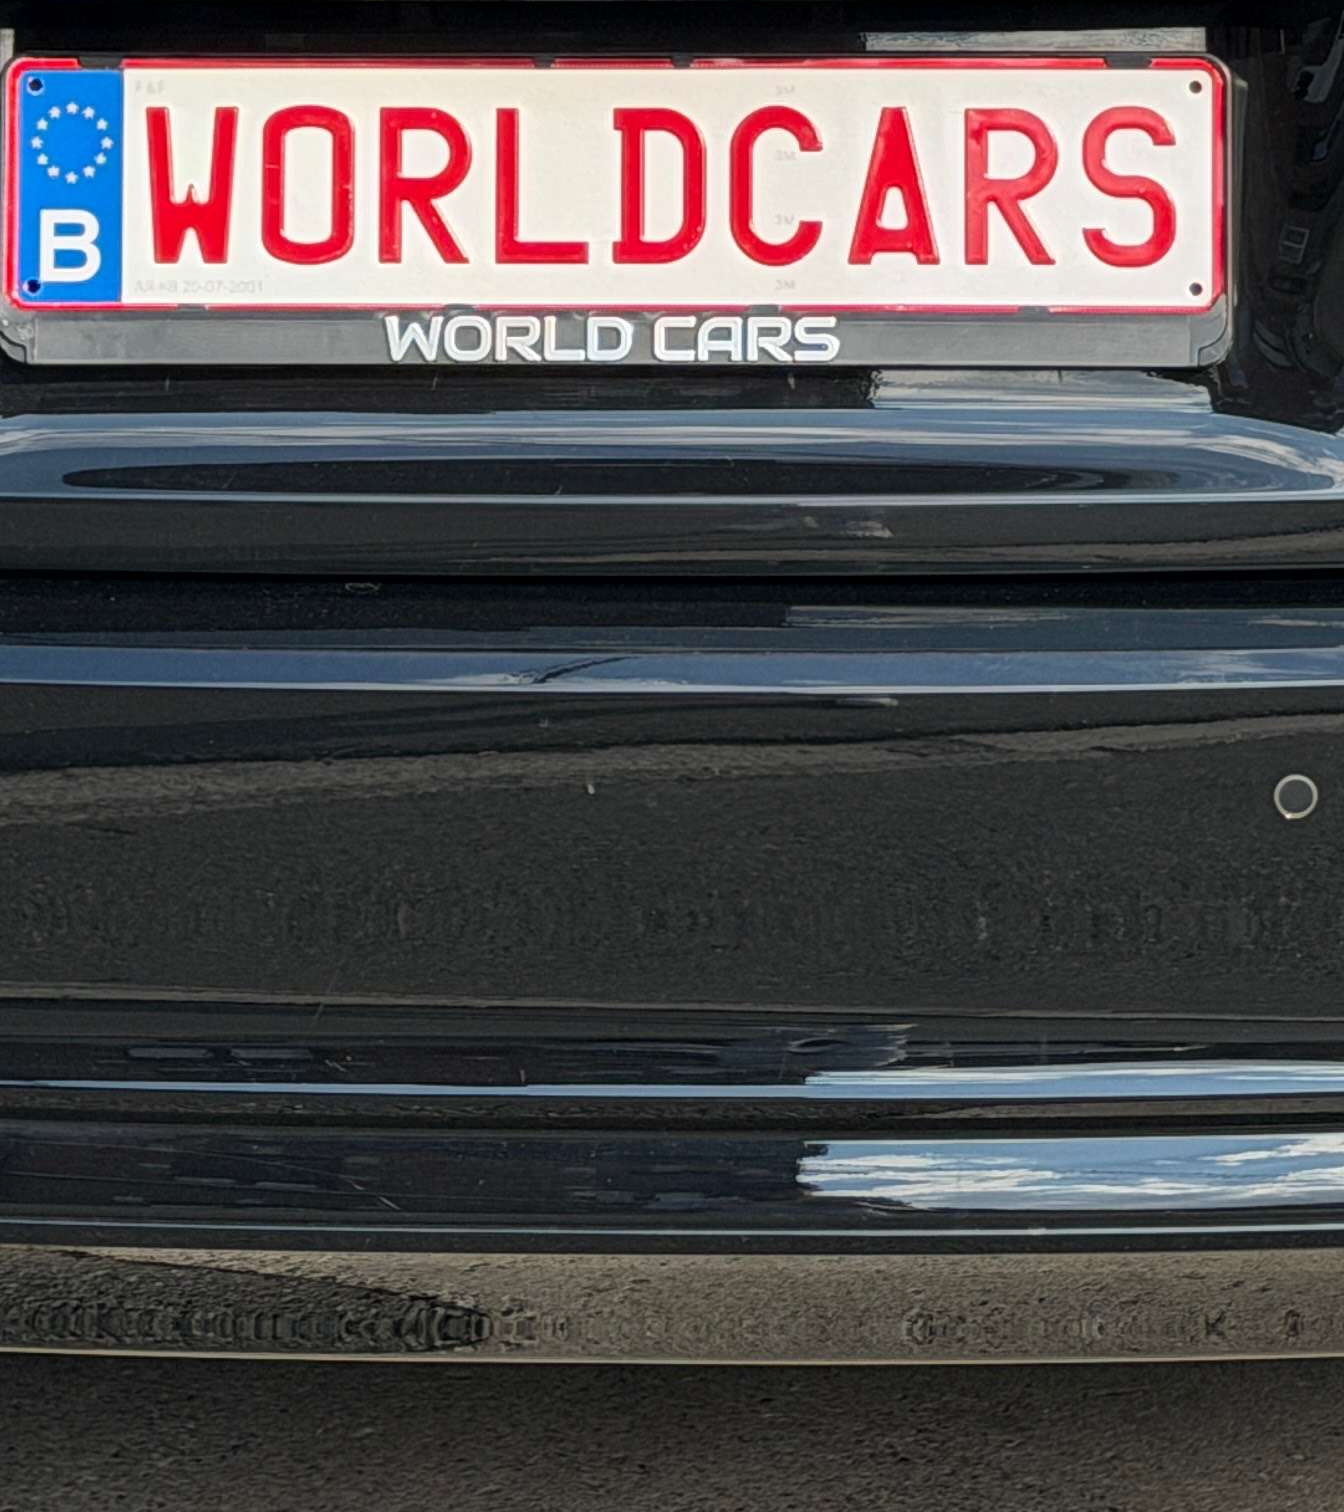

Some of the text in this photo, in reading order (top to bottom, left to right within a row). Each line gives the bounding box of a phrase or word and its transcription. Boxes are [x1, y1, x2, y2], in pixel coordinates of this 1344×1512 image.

[145, 104, 1177, 267] WORLDCARS
[40, 209, 101, 282] B
[384, 315, 841, 363] WORLD CARS
